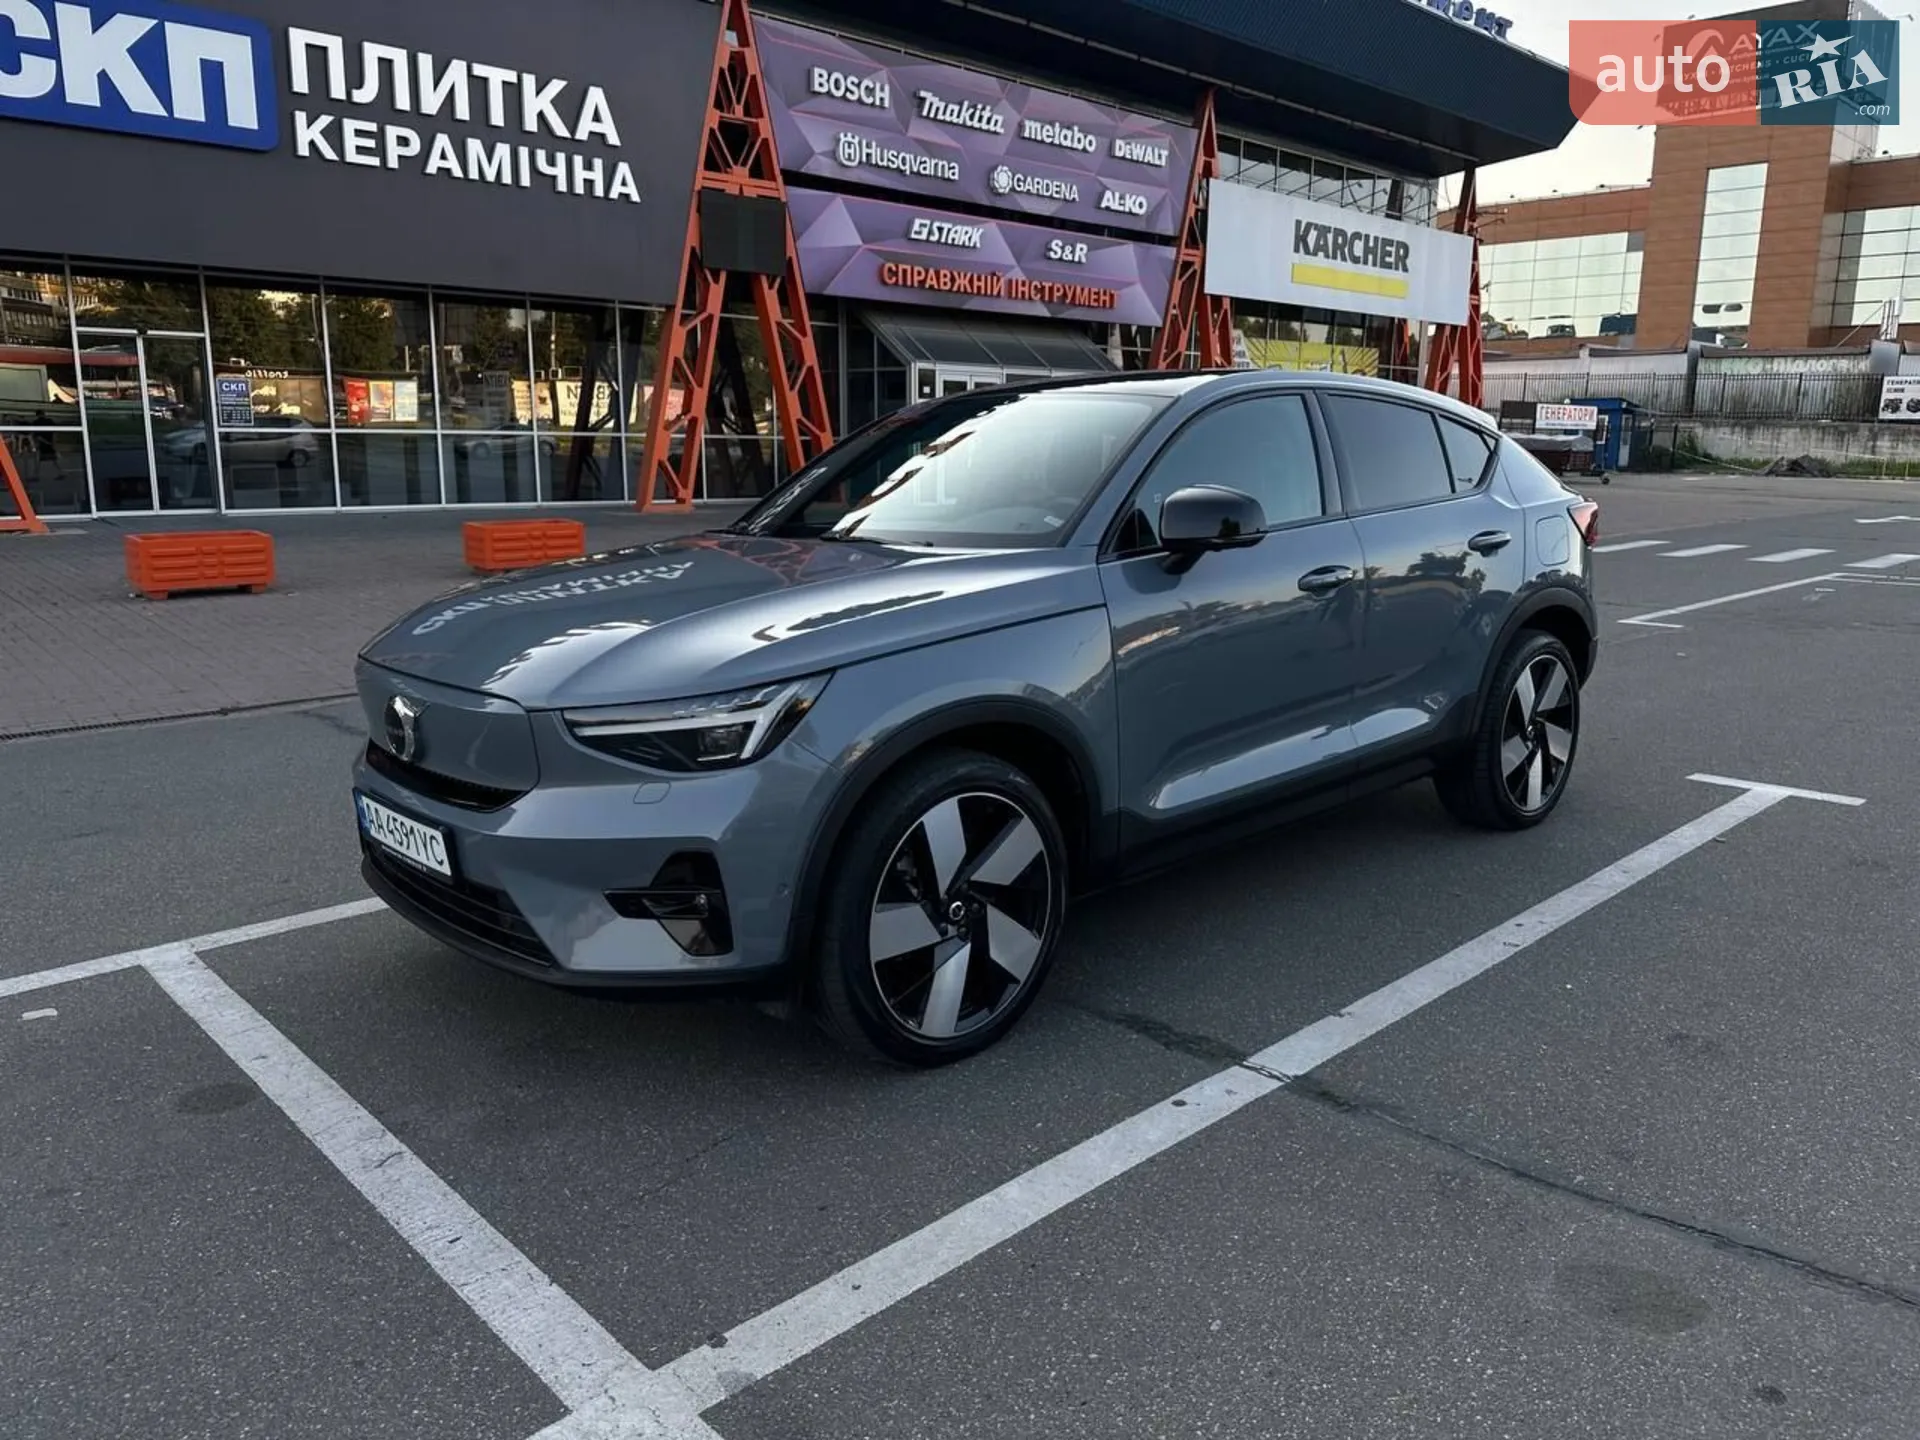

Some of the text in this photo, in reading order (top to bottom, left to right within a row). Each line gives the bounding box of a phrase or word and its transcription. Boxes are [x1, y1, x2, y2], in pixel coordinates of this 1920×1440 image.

[0, 0, 258, 130] СКП
[288, 27, 621, 146] ПЛИТКА
[812, 66, 891, 108] BOSCH
[918, 89, 1005, 134] Makita
[293, 110, 641, 203] КЕРАМІЧНА
[1023, 119, 1096, 152] metabo
[861, 138, 960, 181] Husqvarna
[1013, 173, 1080, 202] GARDENA
[930, 222, 984, 248] STARK
[1049, 239, 1088, 263] S&R
[881, 262, 1120, 309] СПРАВЖНІЙ ІНСТРУМЕНТ
[221, 382, 247, 391] СКП
